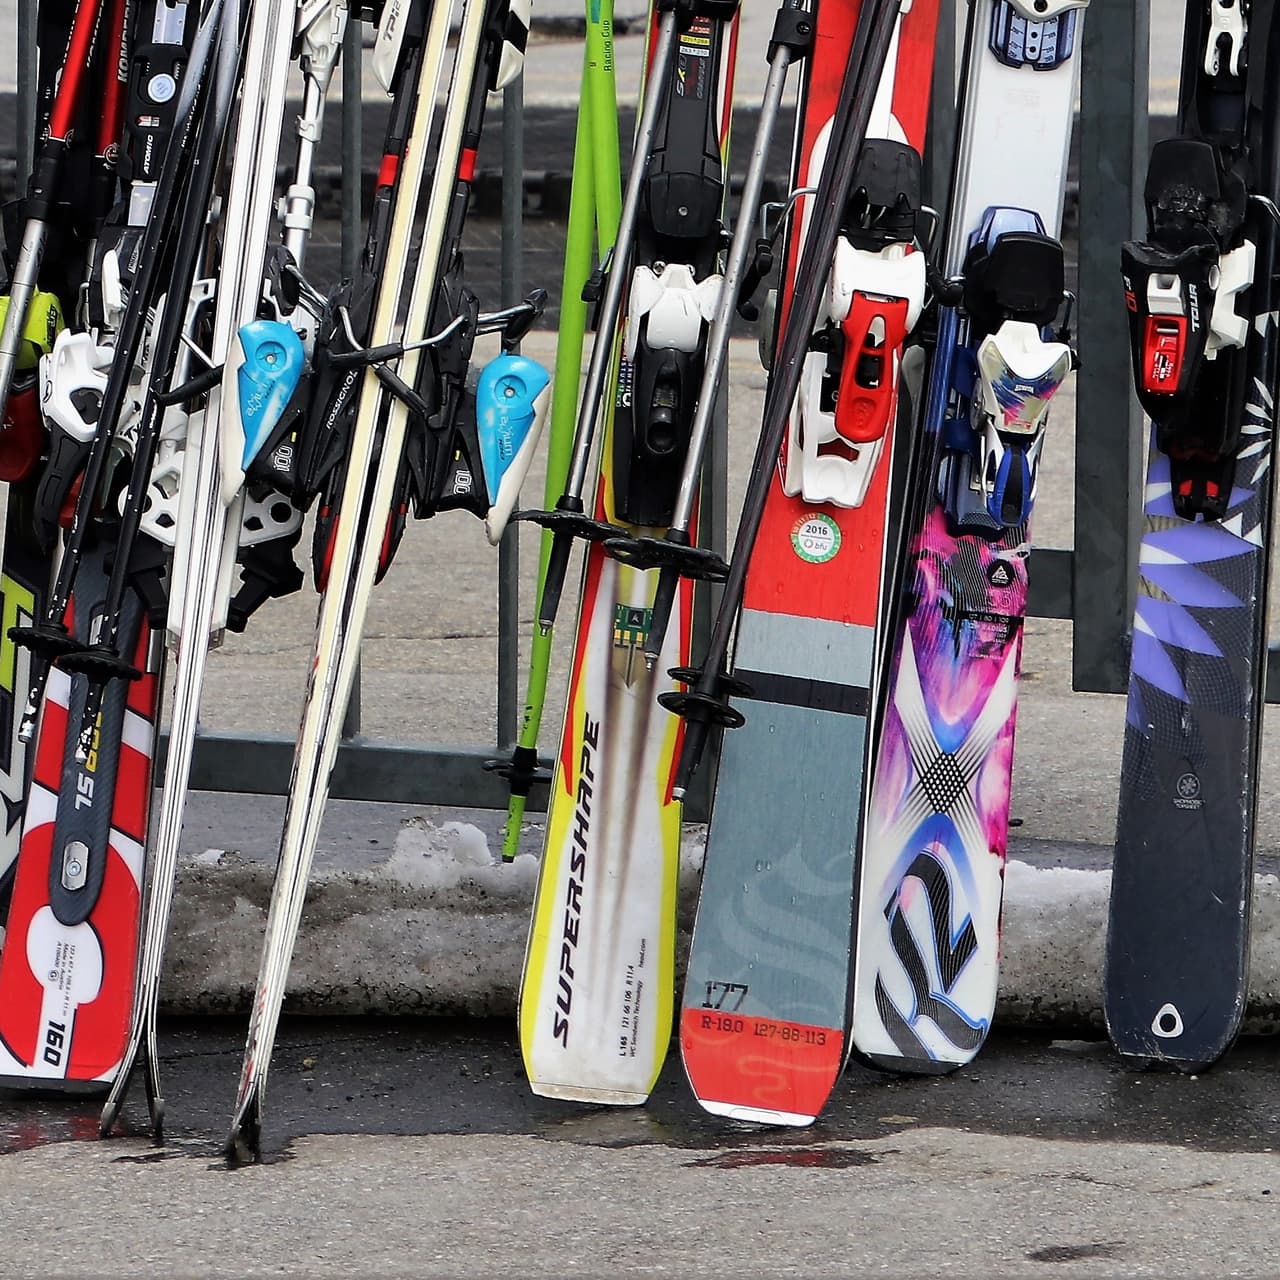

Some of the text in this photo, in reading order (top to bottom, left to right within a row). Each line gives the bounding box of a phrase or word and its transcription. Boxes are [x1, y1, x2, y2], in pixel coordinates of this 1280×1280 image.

[143, 133, 154, 175] ATOMIC
[326, 368, 358, 431] ROSSIGNOL
[805, 524, 828, 536] 2016
[74, 773, 96, 809] SL
[554, 711, 602, 1049] SUPERSHAPE
[637, 938, 647, 968] head.com
[701, 980, 749, 1012] 177
[621, 1016, 630, 1028] 121
[752, 1022, 826, 1046] 127-88-113
[43, 1018, 68, 1069] 160
[619, 1035, 627, 1049] 165
